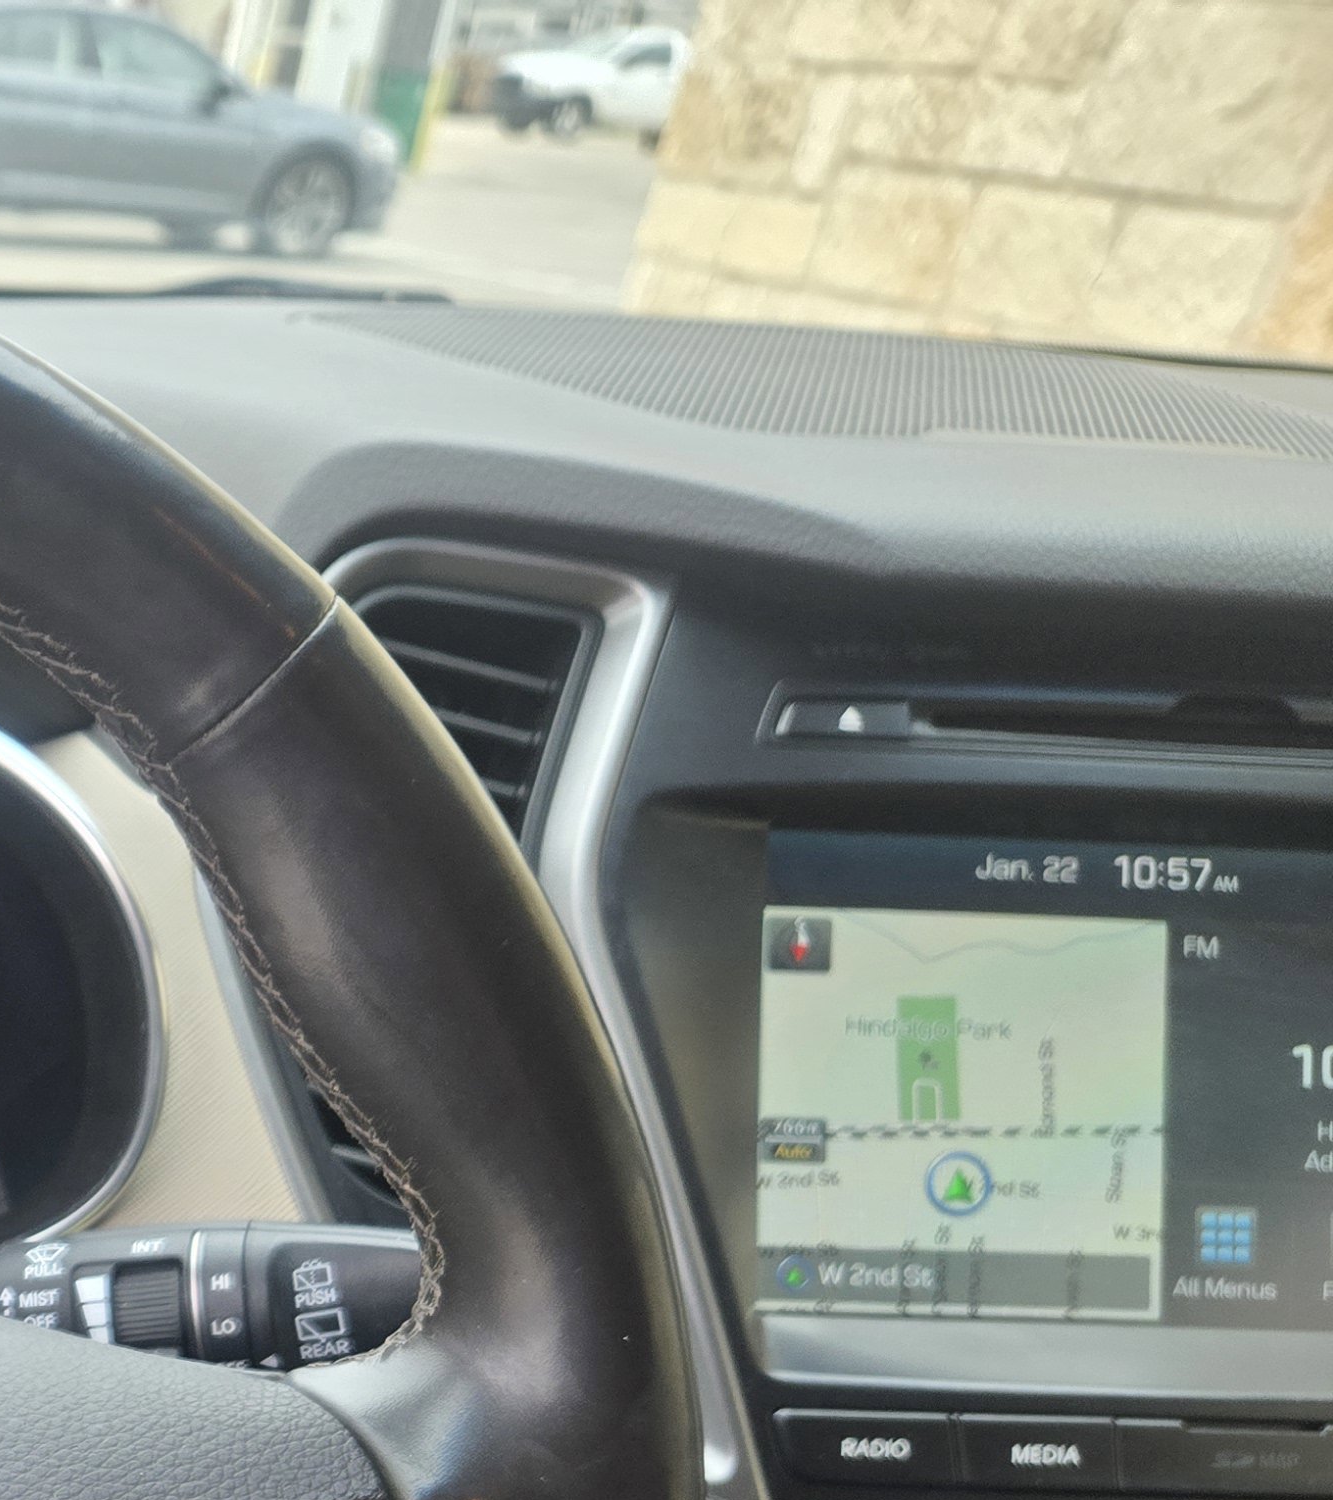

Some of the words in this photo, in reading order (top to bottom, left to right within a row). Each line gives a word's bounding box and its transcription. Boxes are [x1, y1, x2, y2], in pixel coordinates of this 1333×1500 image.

[975, 852, 1033, 881] Jan.
[1043, 855, 1080, 884] 22
[1114, 855, 1212, 892] 10:57
[1214, 875, 1239, 893] AM
[1184, 935, 1219, 959] FM
[958, 1017, 1013, 1041] Park
[131, 1237, 166, 1255] INT
[24, 1262, 65, 1280] PULL
[210, 1272, 231, 1291] HI
[818, 1261, 845, 1285] W
[850, 1262, 899, 1287] 2nd
[903, 1263, 934, 1288] St
[19, 1288, 61, 1308] MIST
[295, 1288, 338, 1309] PUSH
[1173, 1275, 1200, 1298] All
[1205, 1277, 1278, 1300] Menus
[211, 1317, 237, 1336] LO
[300, 1340, 351, 1360] REAR
[841, 1437, 911, 1461] RADIO
[1011, 1444, 1081, 1467] MEDIA
